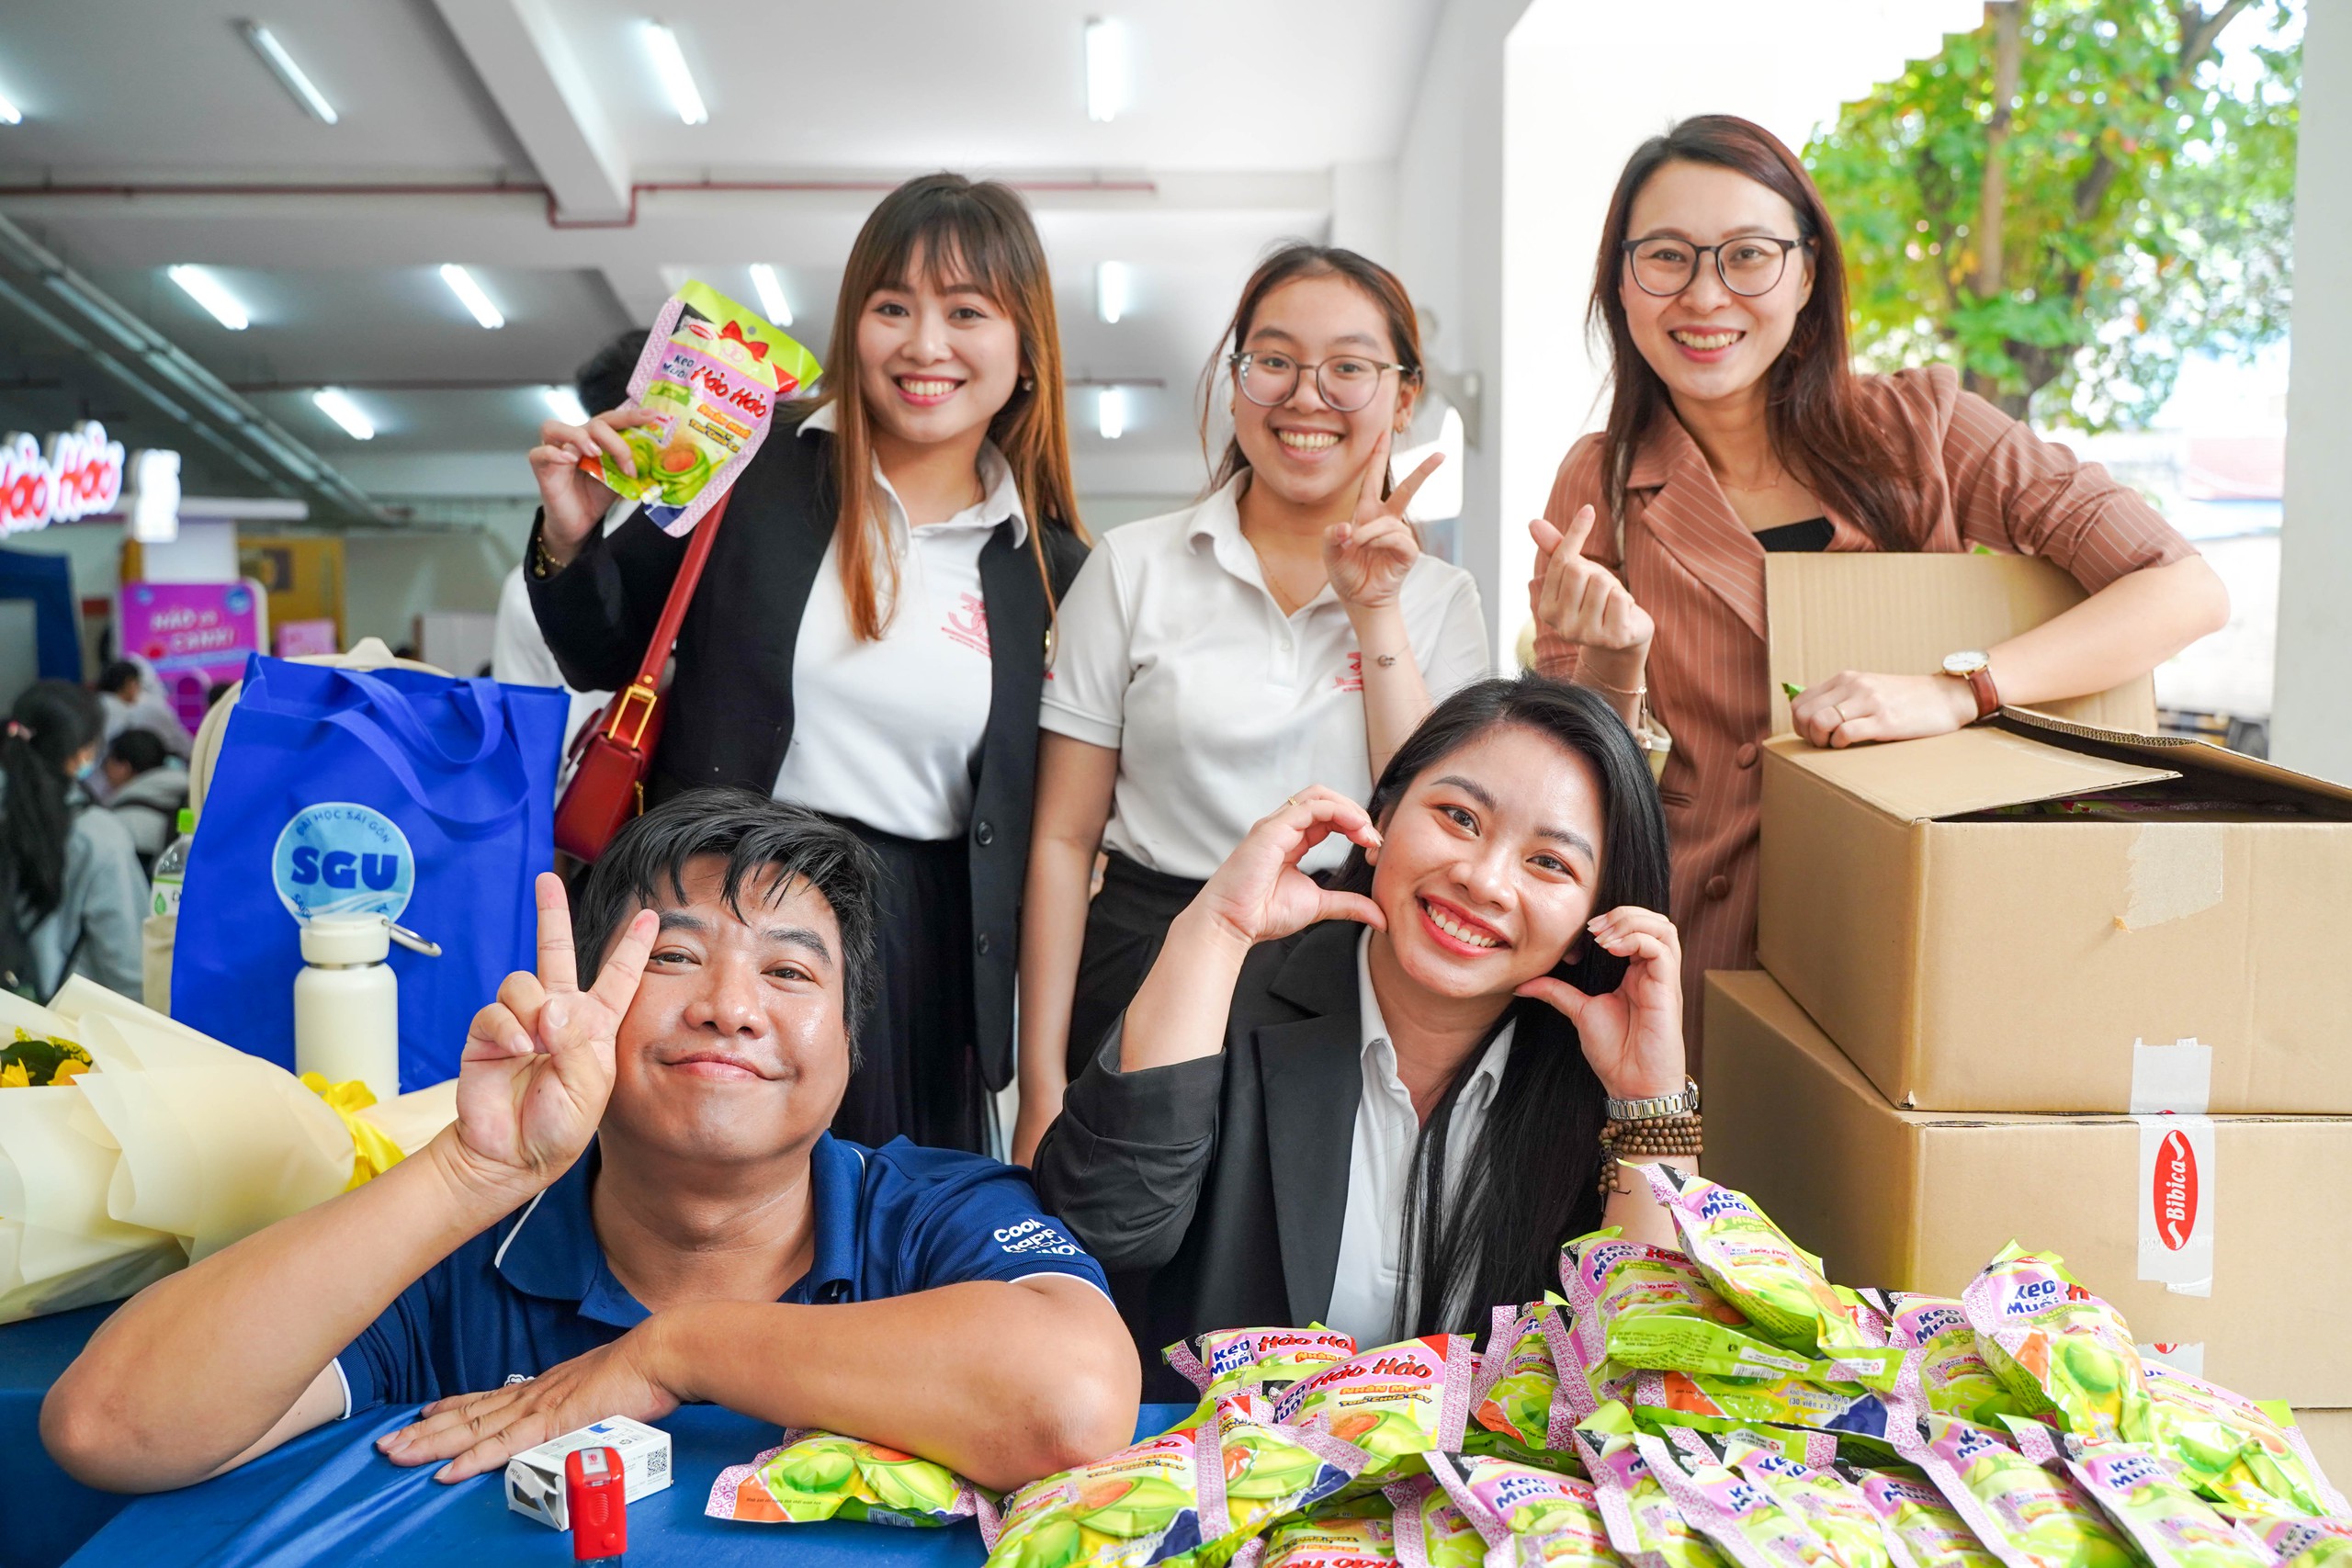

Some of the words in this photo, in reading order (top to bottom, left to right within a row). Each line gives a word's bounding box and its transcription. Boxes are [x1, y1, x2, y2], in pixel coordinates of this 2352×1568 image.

[729, 388, 767, 418] Hảo
[291, 845, 399, 891] SGU
[2165, 1161, 2186, 1222] Bibica
[993, 1218, 1046, 1243] Cook
[1214, 1339, 1251, 1362] Kẹo
[1257, 1334, 1313, 1353] Hảo
[1310, 1364, 1367, 1390] Hảo
[1372, 1354, 1433, 1379] Hảo
[1279, 1393, 1306, 1421] uối
